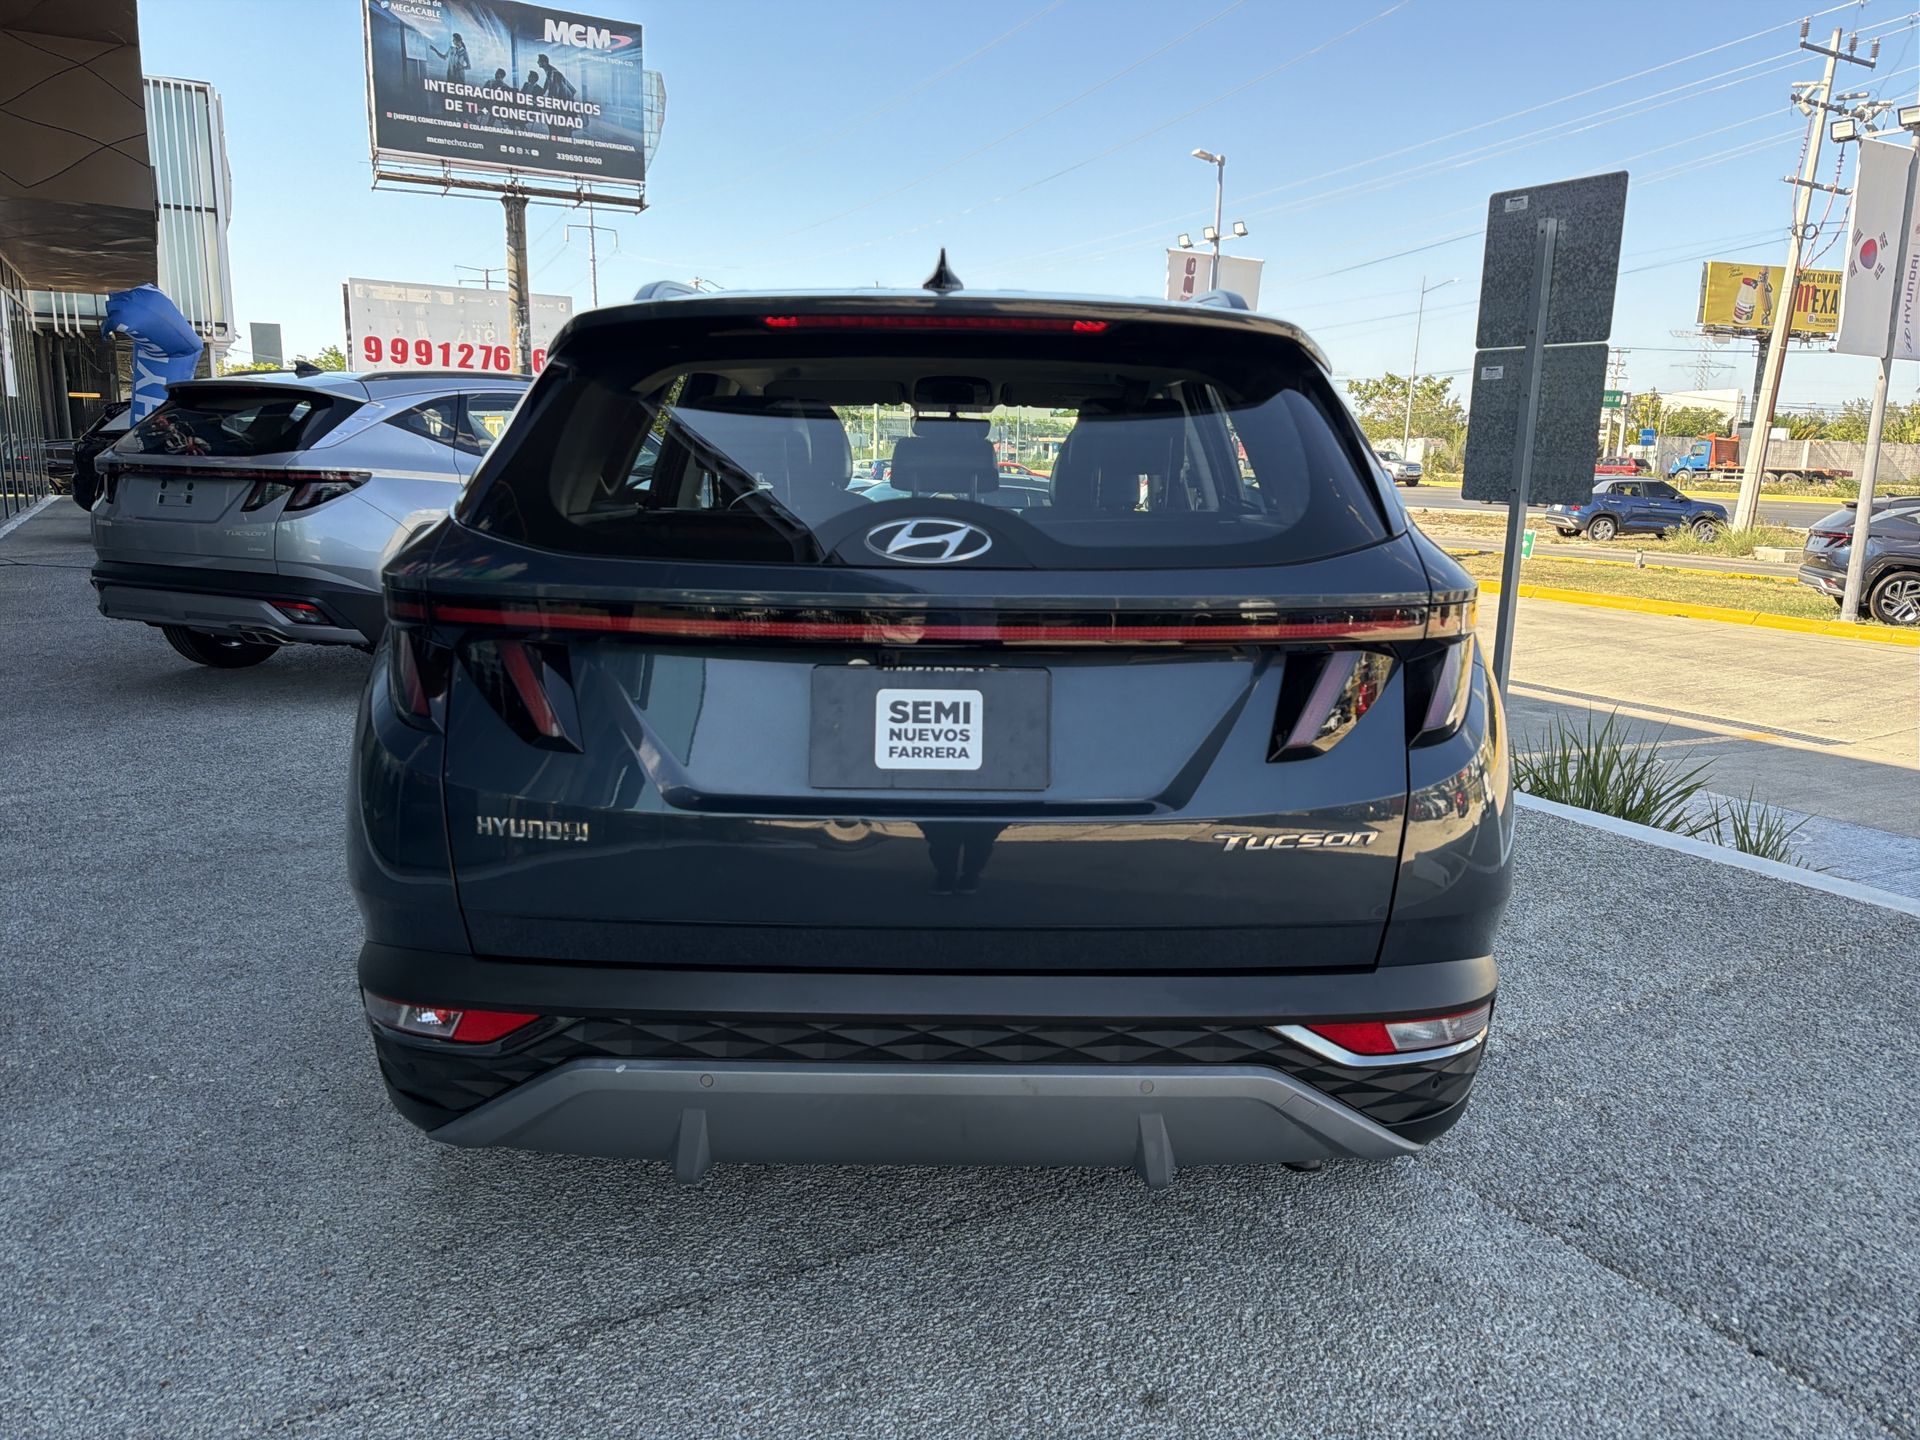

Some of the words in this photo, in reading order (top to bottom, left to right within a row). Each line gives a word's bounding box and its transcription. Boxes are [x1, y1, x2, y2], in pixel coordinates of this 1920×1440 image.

[391, 2, 441, 18] MEGACABLE
[543, 18, 611, 50] MCM
[424, 79, 514, 103] INTEGRACIÓN
[516, 92, 534, 106] DE
[536, 95, 601, 116] SERVICIOS
[417, 116, 462, 128] CONECTIVIDAD
[445, 98, 464, 113] DE
[466, 101, 479, 114] TI
[491, 105, 584, 129] CONECTIVIDAD
[426, 136, 484, 150] mcmtechco.com
[595, 141, 636, 152] CONVERGENCIA
[1904, 254, 1920, 324] HYUNDAI
[888, 700, 971, 725] SEMI
[888, 728, 971, 742] NUEVOS
[888, 746, 970, 759] FARRERA
[476, 815, 589, 842] HYUNDAI
[1212, 830, 1380, 852] TUCSON
